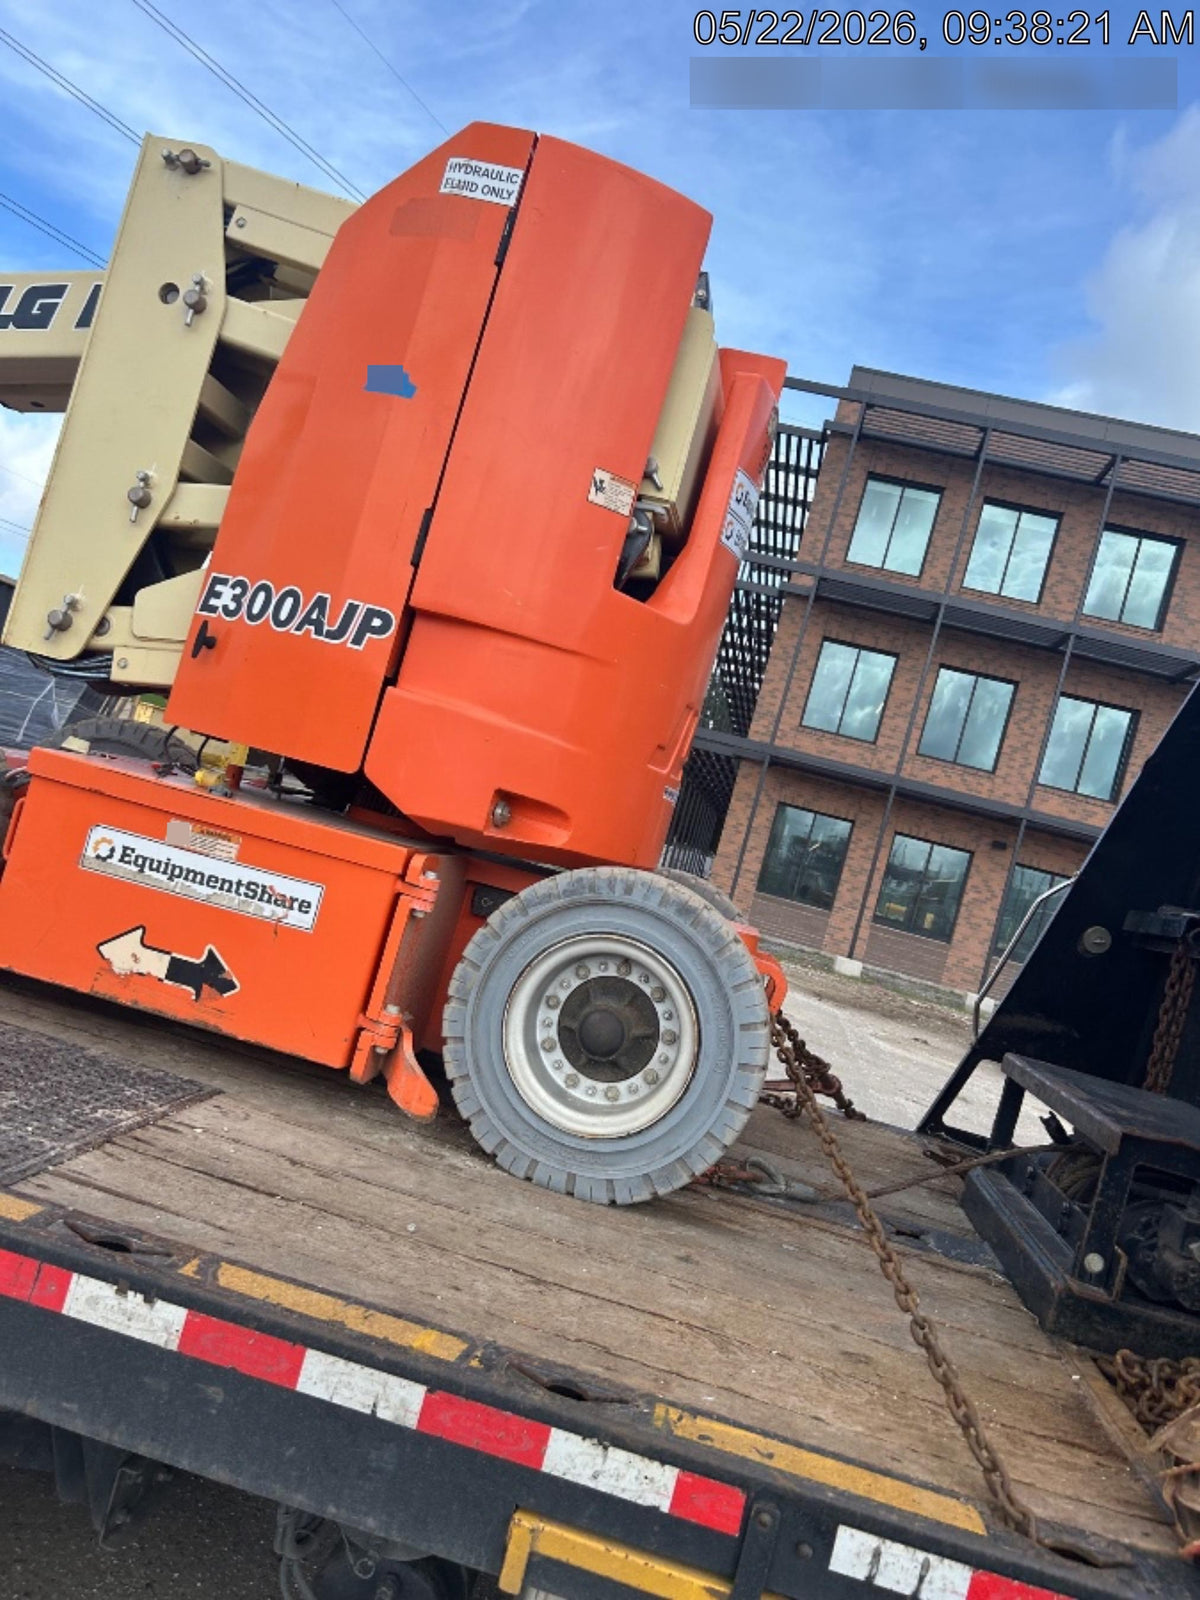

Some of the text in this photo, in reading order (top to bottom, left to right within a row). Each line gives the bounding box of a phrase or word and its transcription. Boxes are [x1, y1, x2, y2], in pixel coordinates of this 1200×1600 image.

[449, 162, 519, 184] HYDRAULIC
[481, 185, 515, 200] ONLY
[197, 573, 395, 650] E300AJP
[118, 846, 312, 914] EquipmentShare
